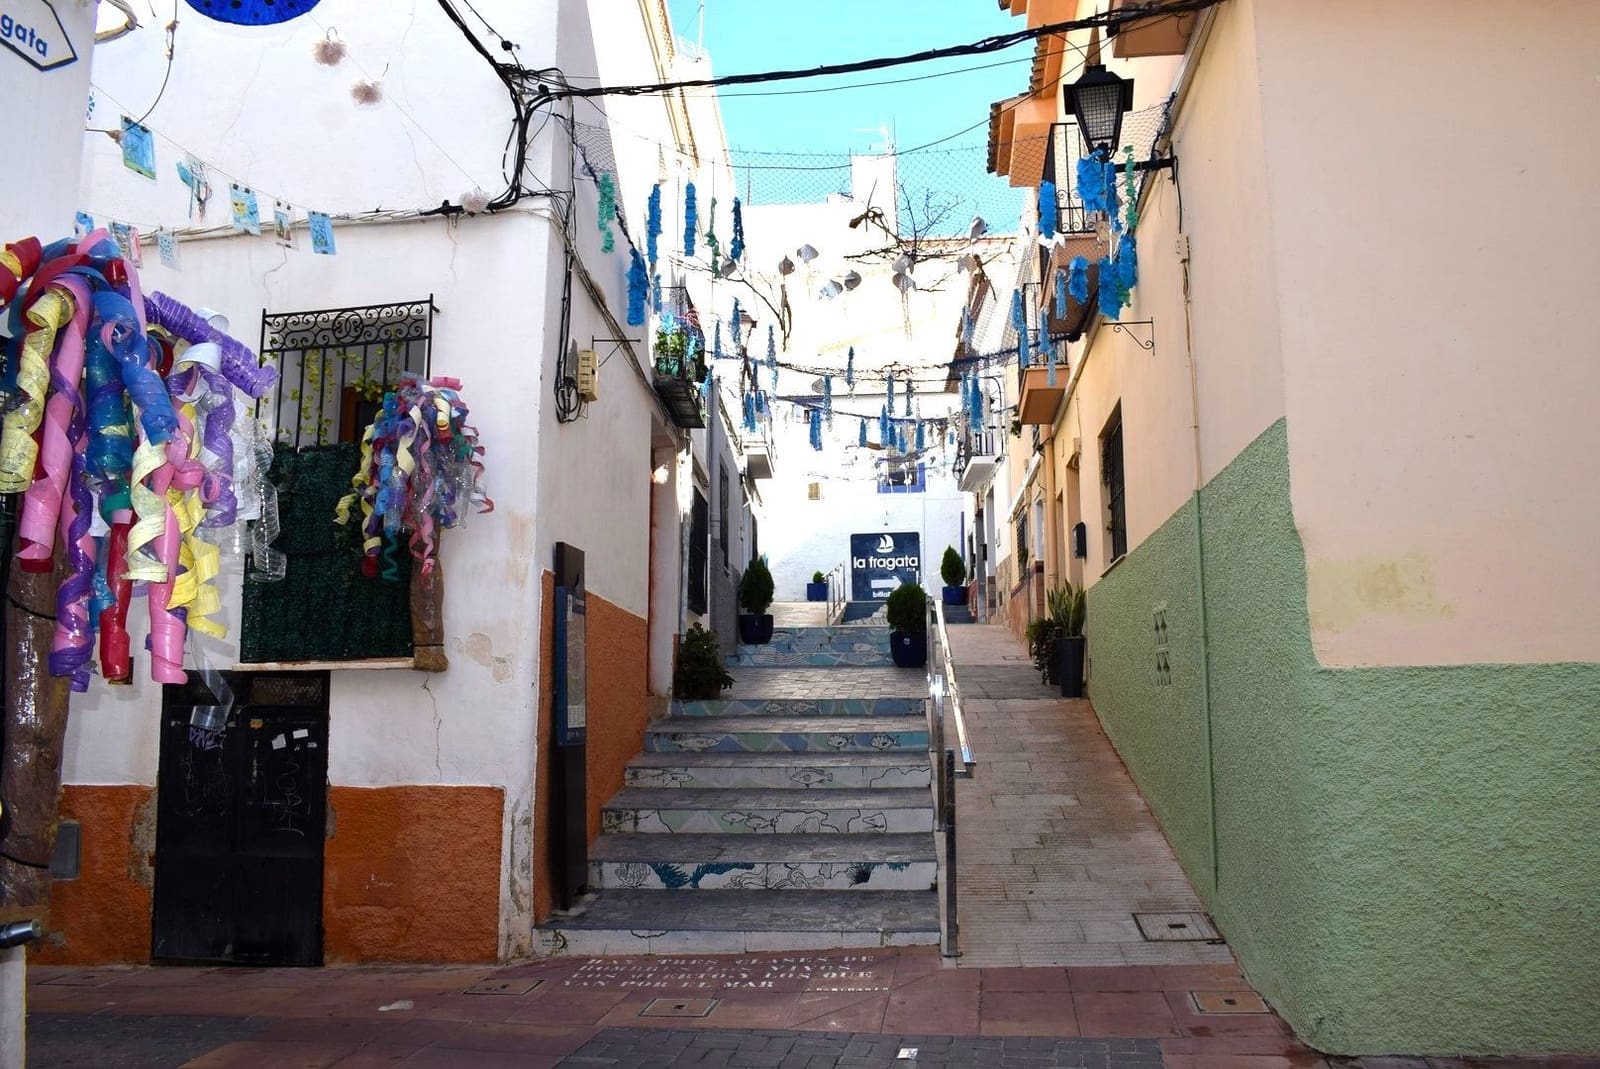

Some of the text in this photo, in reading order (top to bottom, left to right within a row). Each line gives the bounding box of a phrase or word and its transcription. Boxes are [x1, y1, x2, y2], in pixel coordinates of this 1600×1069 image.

[0, 14, 48, 58] gata
[853, 554, 919, 571] la fragata
[734, 957, 830, 965] CLASES
[619, 980, 669, 988] POR
[722, 980, 774, 988] MAR
